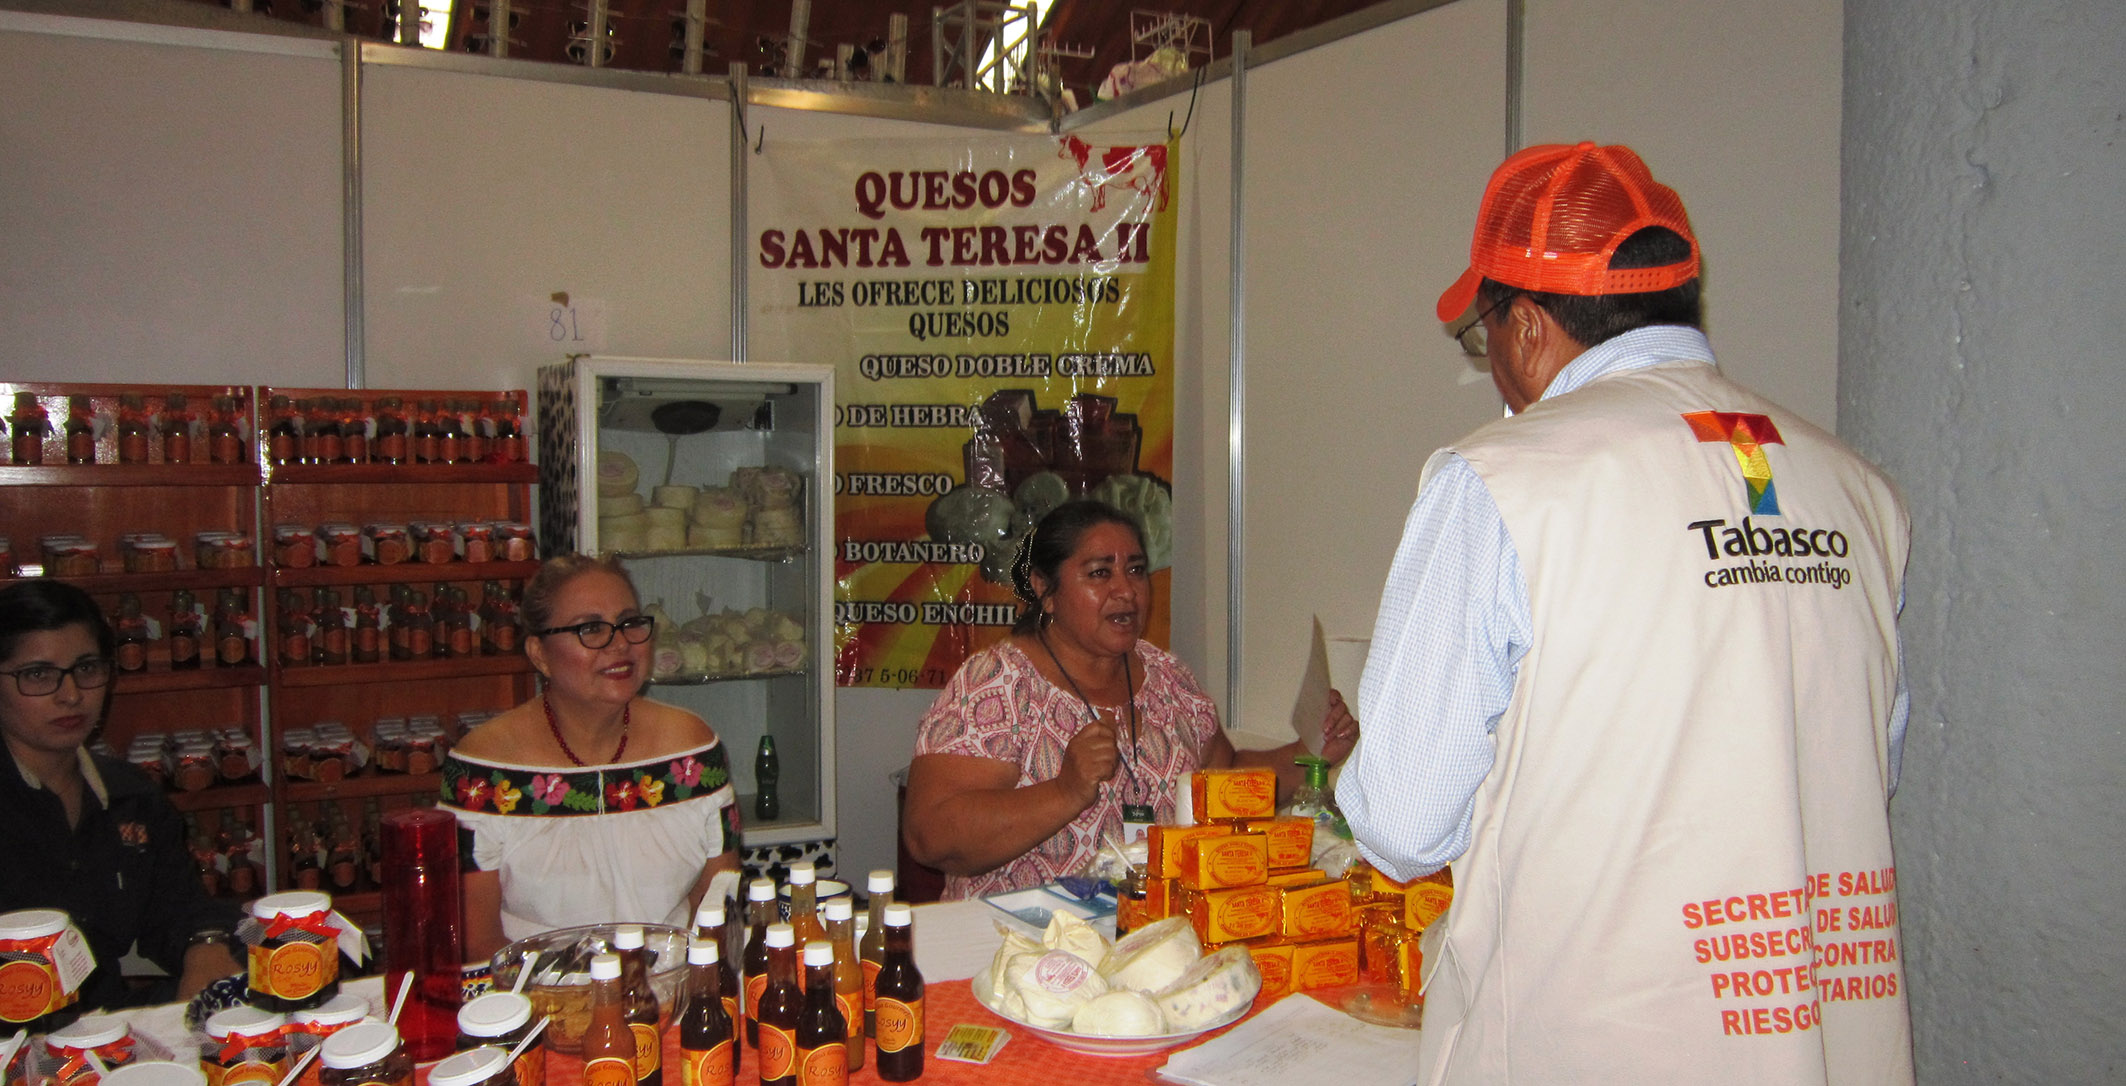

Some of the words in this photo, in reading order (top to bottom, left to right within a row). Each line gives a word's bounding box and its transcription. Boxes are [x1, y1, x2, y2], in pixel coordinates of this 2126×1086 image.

[854, 169, 1037, 220] QUESOS
[759, 227, 911, 269] SANTA
[921, 223, 1104, 266] TERESA
[1113, 222, 1150, 264] II
[798, 281, 845, 308] LES
[852, 280, 954, 307] OFRECE
[961, 277, 1120, 306] DELICIOSOS
[550, 308, 584, 341] 81
[909, 312, 1010, 342] QUESOS
[860, 354, 951, 381] QUESO
[955, 354, 1051, 378] DOBLE
[1056, 353, 1155, 377] CREMA
[847, 404, 887, 428] DE
[891, 404, 983, 428] HEBRA
[848, 472, 954, 496] FRESCO
[844, 541, 986, 564] BOTANERO
[1687, 516, 1849, 560] Tabasco
[1704, 559, 1783, 588] cambia
[1785, 561, 1851, 590] contigo
[1837, 867, 1896, 896] SALUD
[1816, 908, 1841, 933] DE
[1847, 902, 1896, 931] SALUD
[1813, 938, 1896, 969] CONTRA
[1818, 972, 1897, 1003] TARIOS
